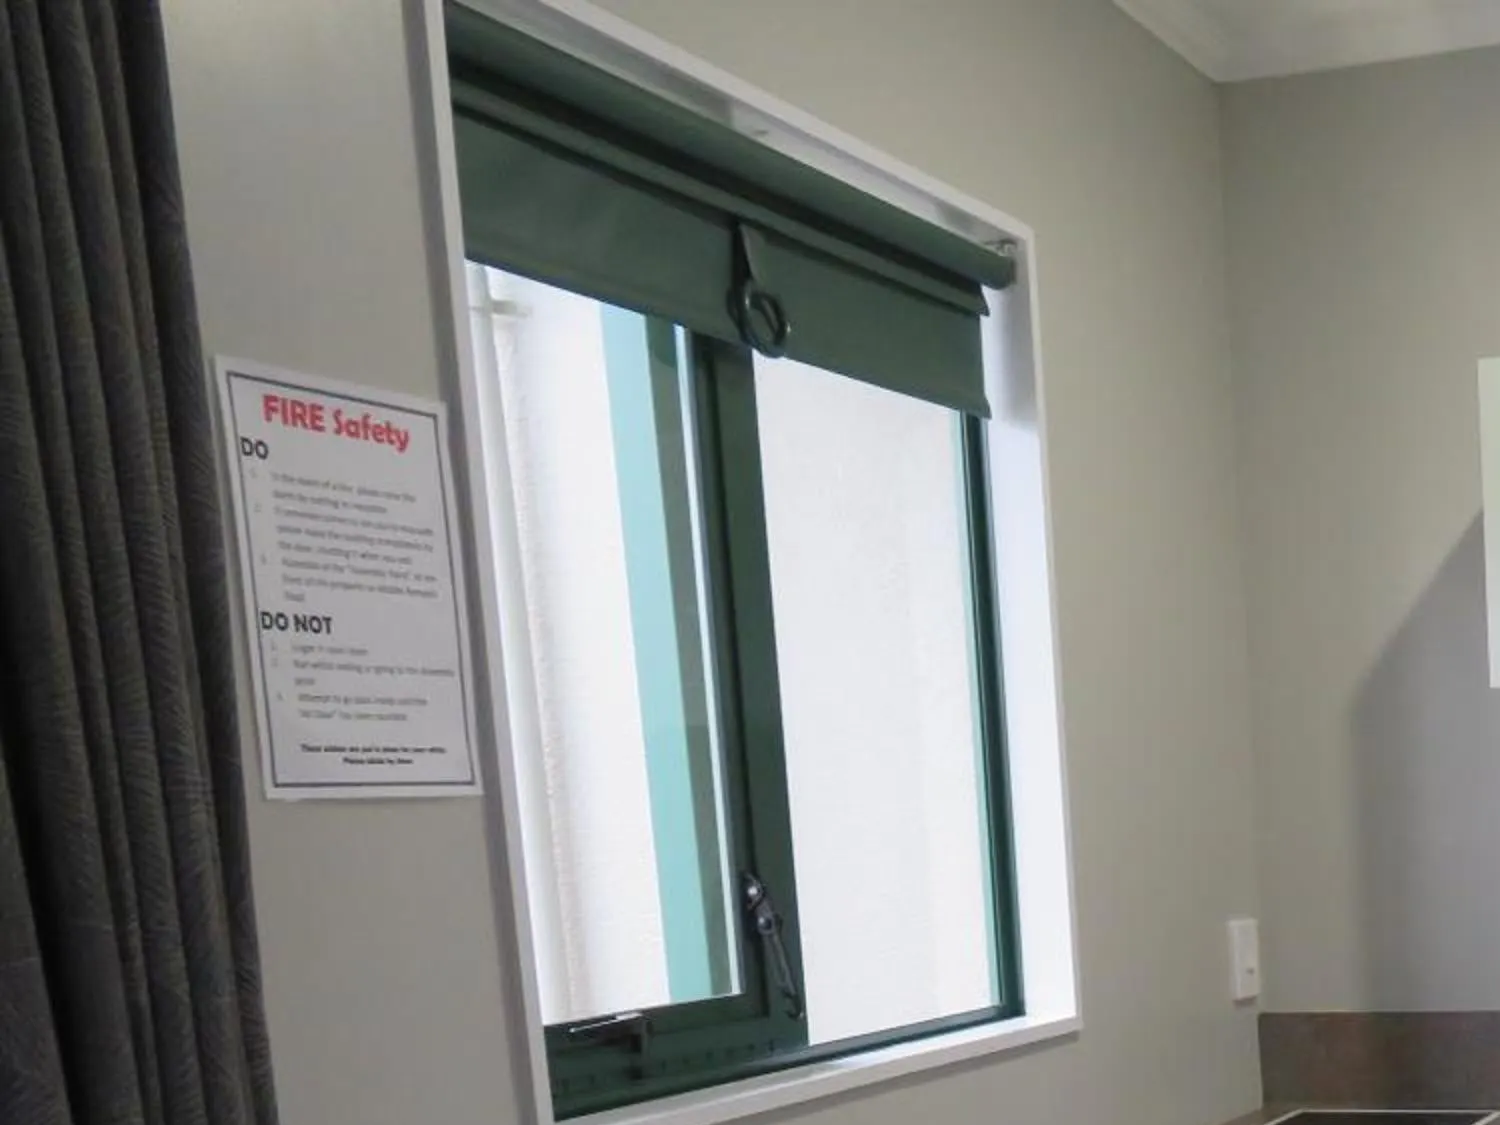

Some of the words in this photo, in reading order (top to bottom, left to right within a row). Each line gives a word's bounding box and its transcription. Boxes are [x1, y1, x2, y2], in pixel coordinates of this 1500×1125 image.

[262, 394, 325, 432] FIRE
[332, 409, 409, 452] Safety
[240, 436, 269, 460] DO
[261, 611, 289, 631] DO
[294, 614, 332, 634] NOT
